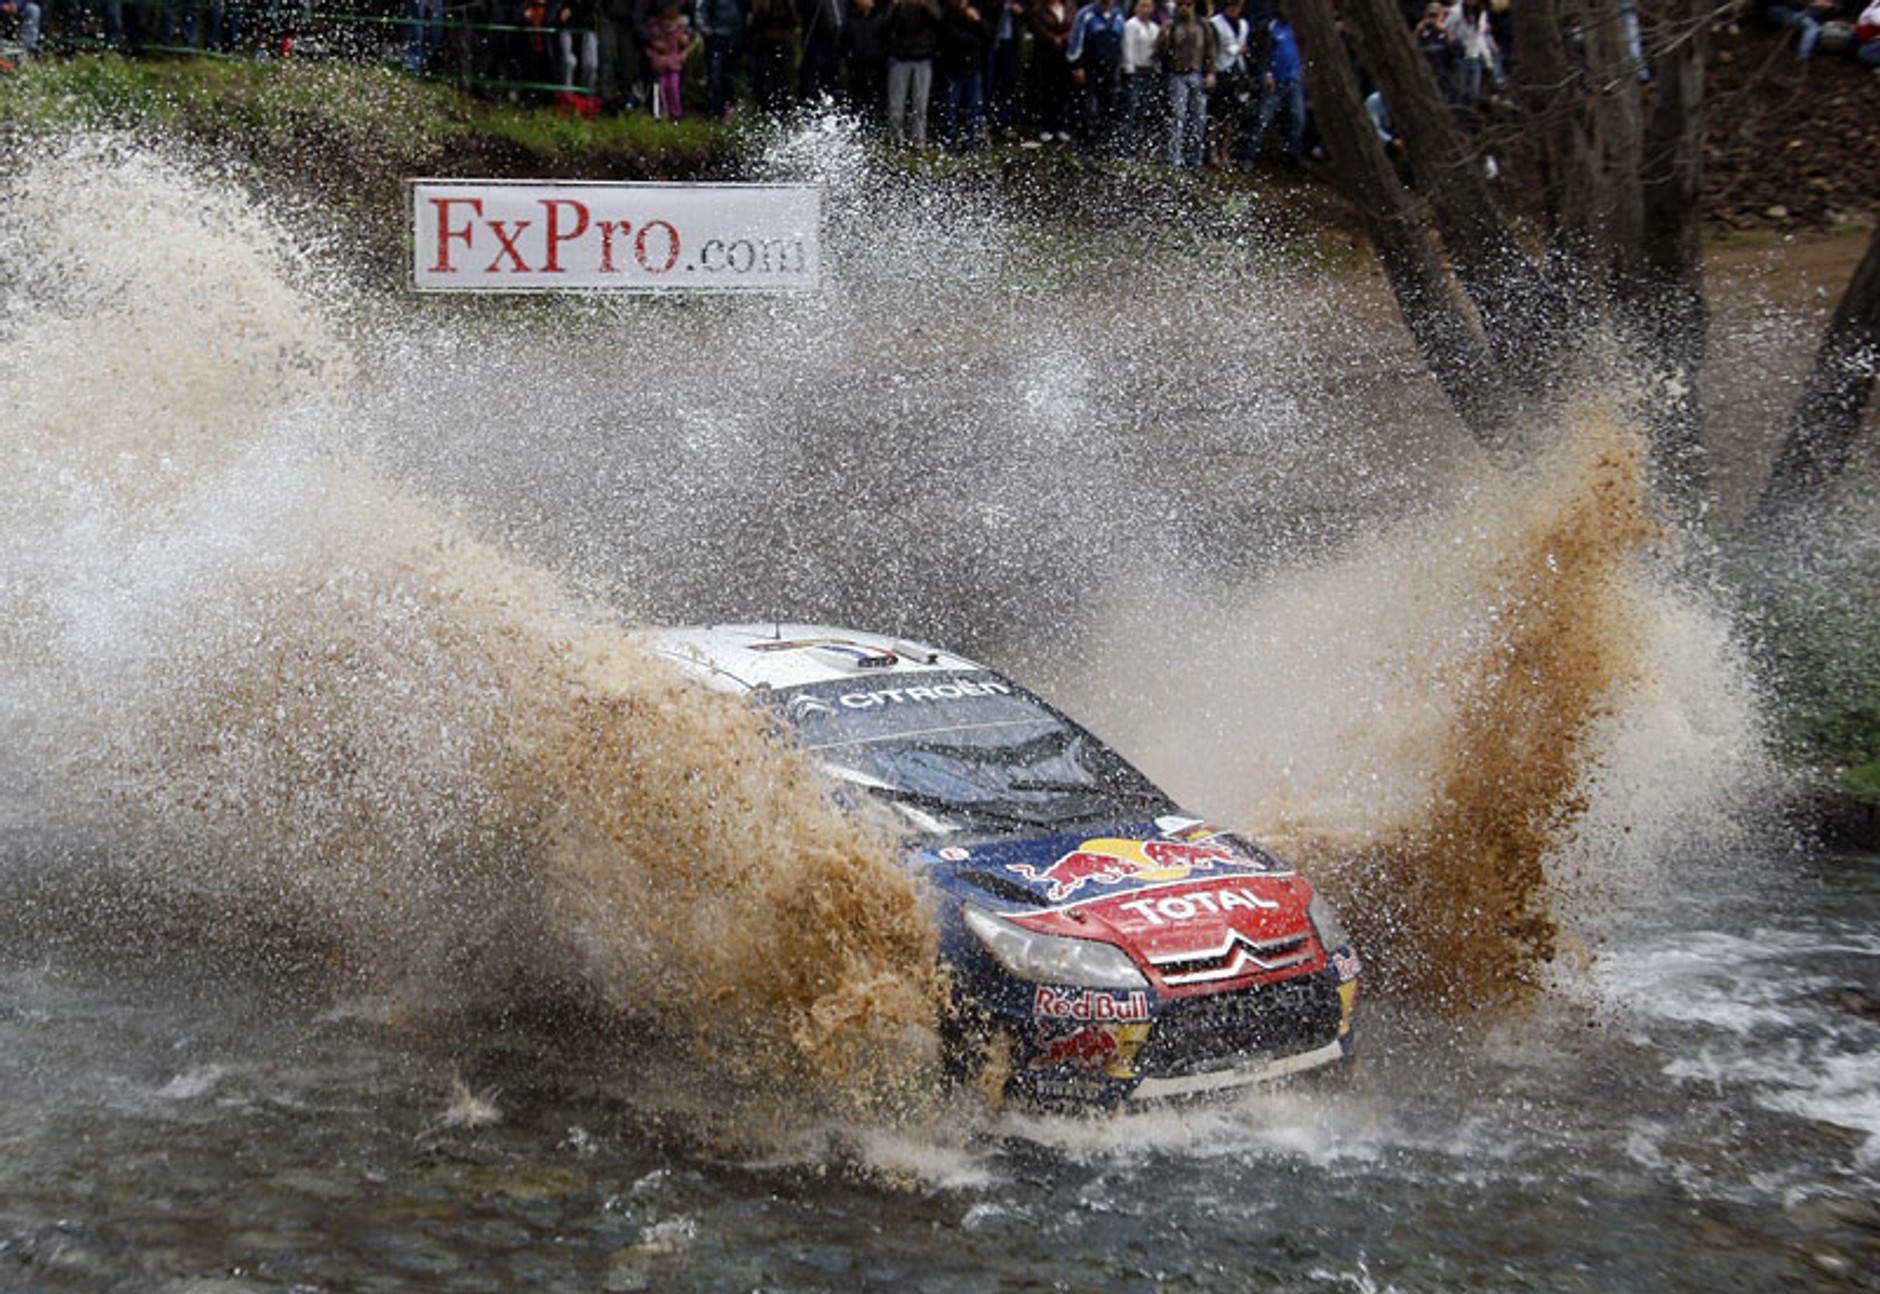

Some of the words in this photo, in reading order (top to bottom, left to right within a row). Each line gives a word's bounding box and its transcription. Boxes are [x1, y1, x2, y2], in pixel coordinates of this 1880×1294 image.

[427, 198, 803, 274] FxPro.com
[1119, 888, 1280, 925] TOTAL
[1034, 985, 1092, 1020] Red
[1094, 990, 1149, 1020] Bull
